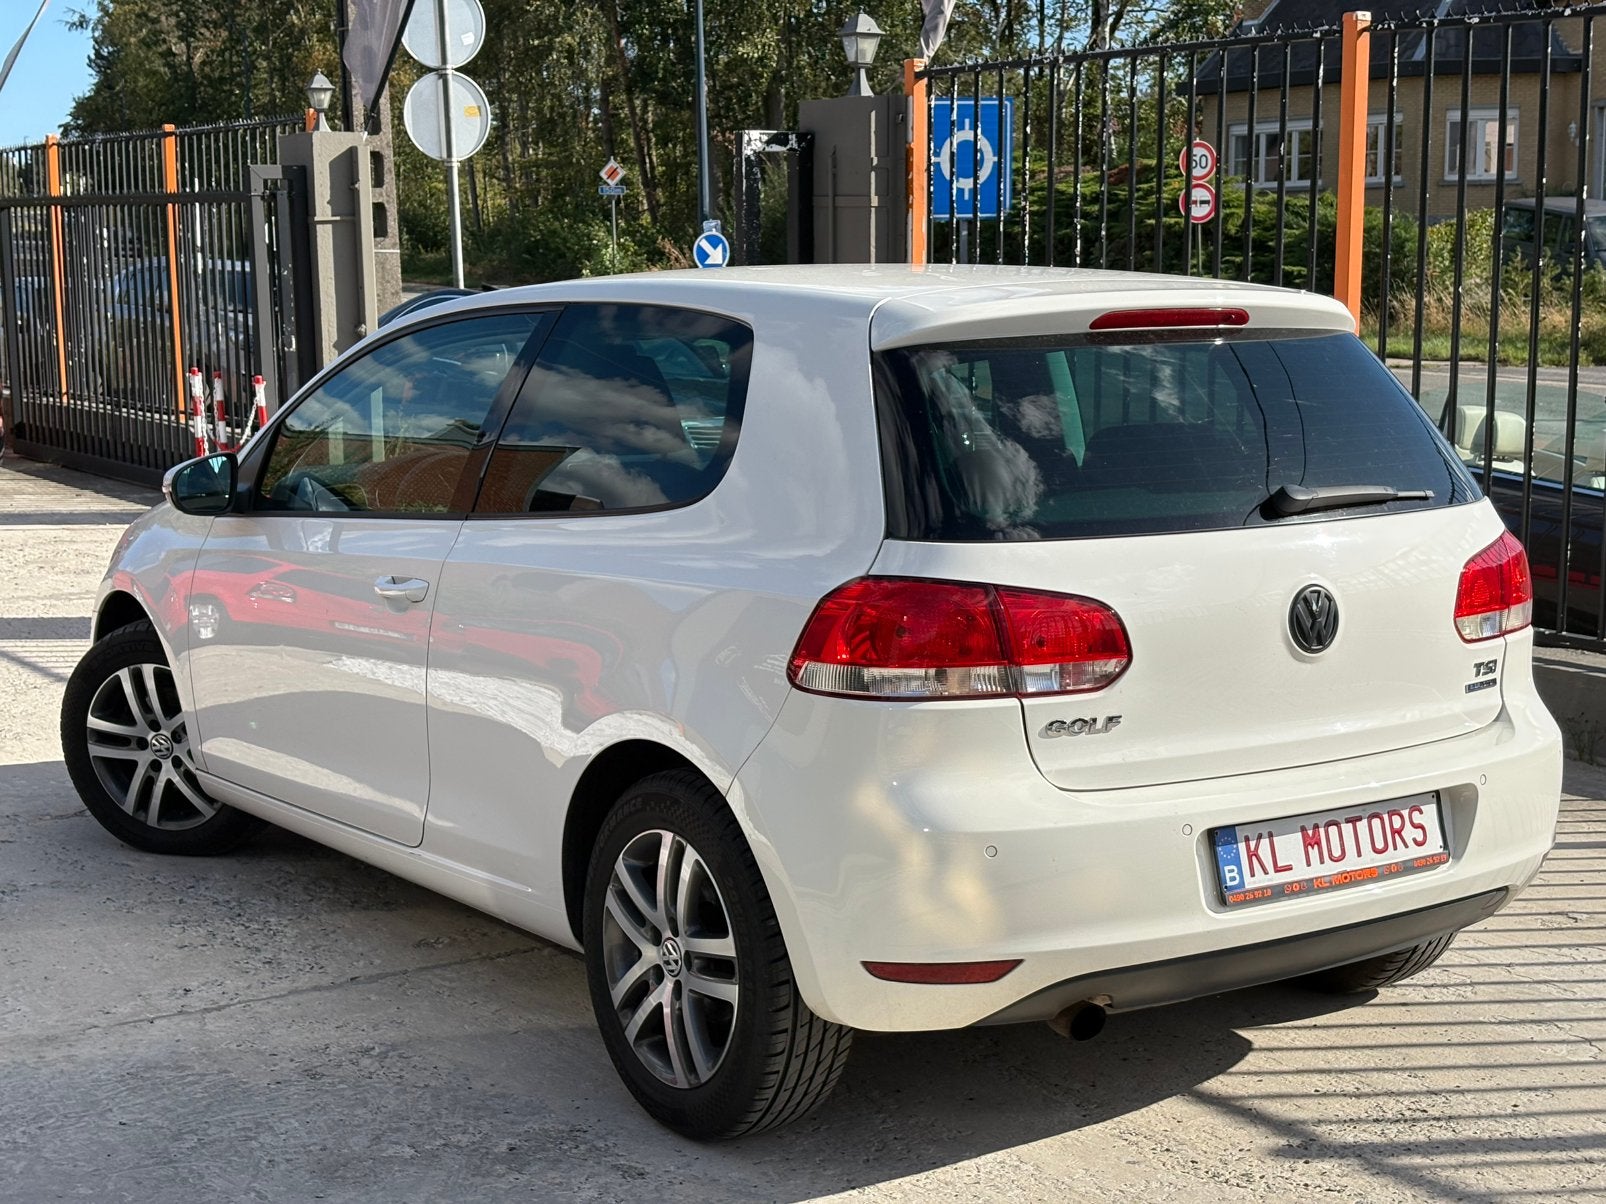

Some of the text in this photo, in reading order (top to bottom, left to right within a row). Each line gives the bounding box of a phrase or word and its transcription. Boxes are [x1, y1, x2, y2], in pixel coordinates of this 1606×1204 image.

[1192, 154, 1208, 169] 50
[1044, 714, 1122, 738] GOLF
[1243, 804, 1428, 878] KL MOTORS
[1224, 864, 1241, 886] B
[1313, 867, 1379, 889] KL MOTORS
